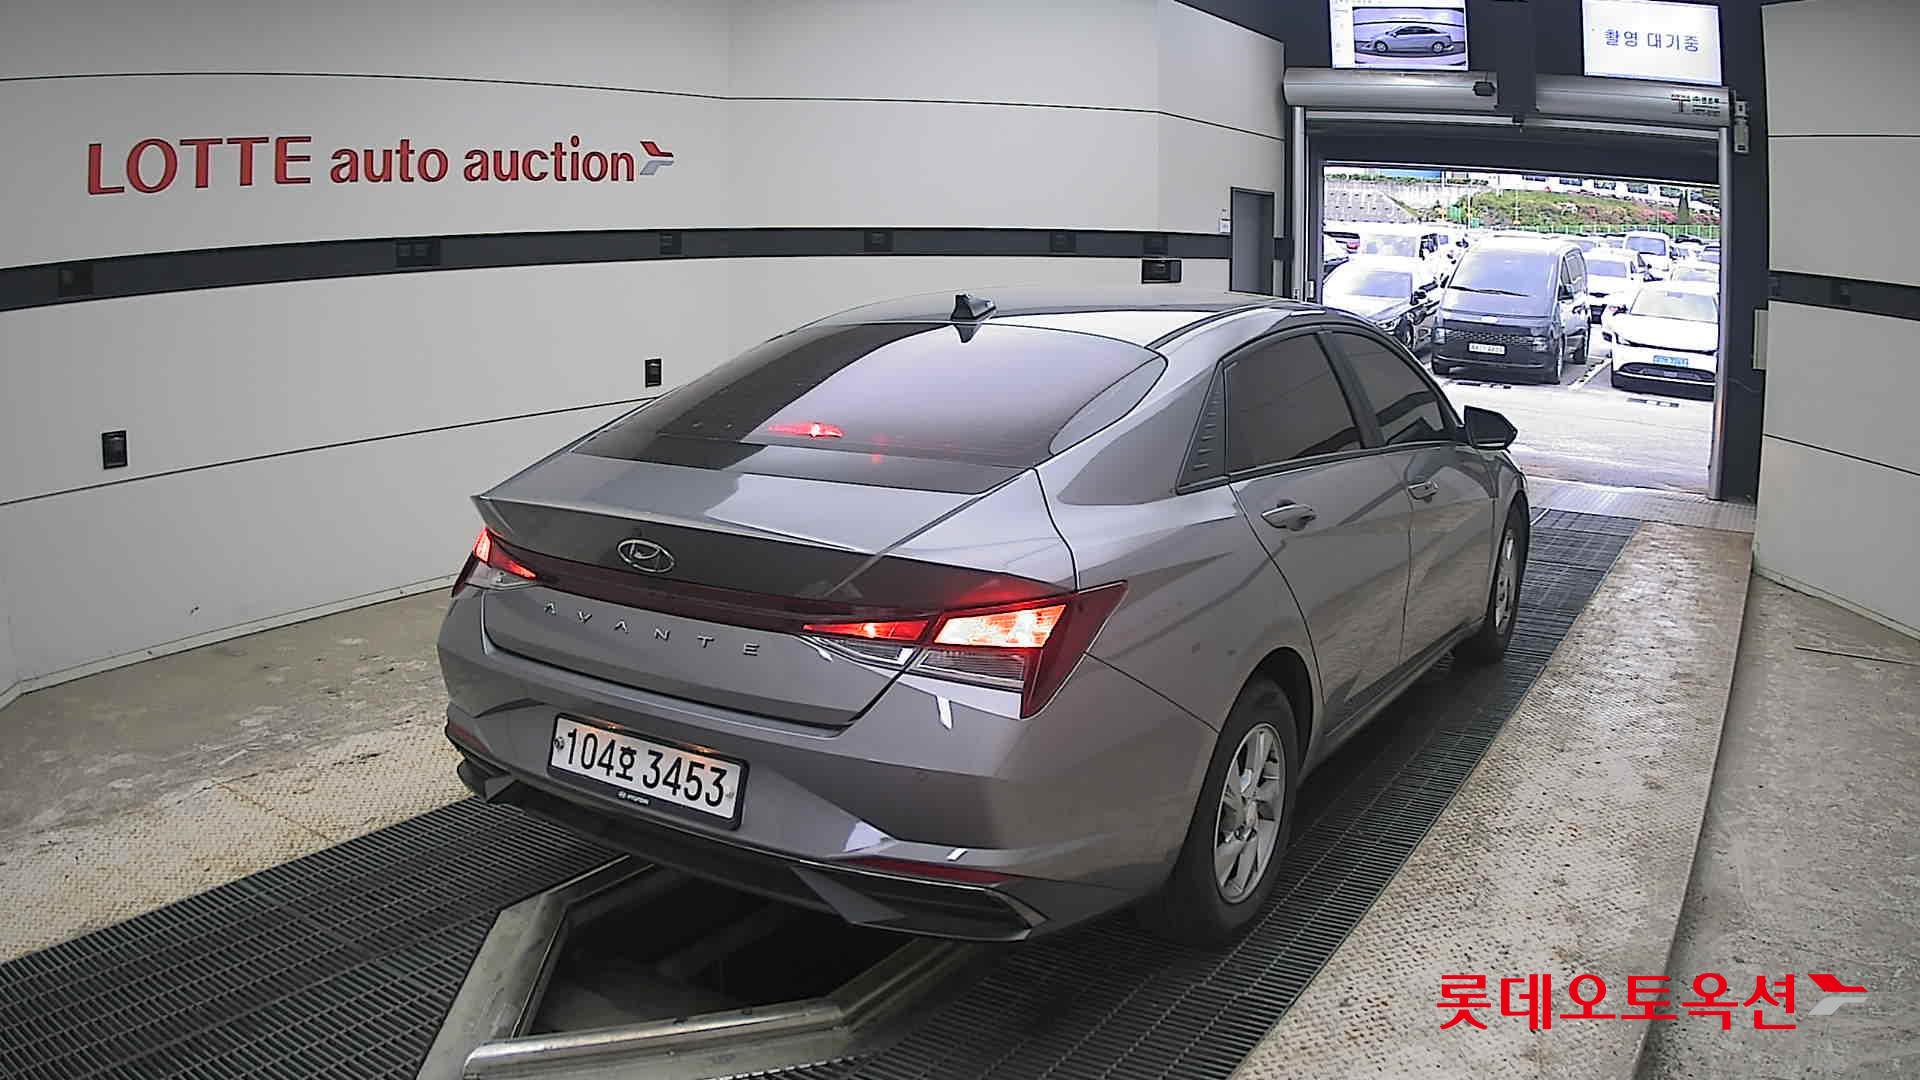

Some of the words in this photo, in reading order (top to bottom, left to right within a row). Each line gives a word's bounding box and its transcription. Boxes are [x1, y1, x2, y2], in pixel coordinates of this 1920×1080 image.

[1605, 28, 1638, 48] 촬영
[1647, 32, 1699, 53] 대기중
[87, 135, 312, 195] LOTTE
[329, 138, 449, 184] auto
[463, 135, 635, 183] auction
[544, 600, 760, 657] AVANTE
[567, 727, 637, 782] 104호
[642, 749, 728, 808] 3453
